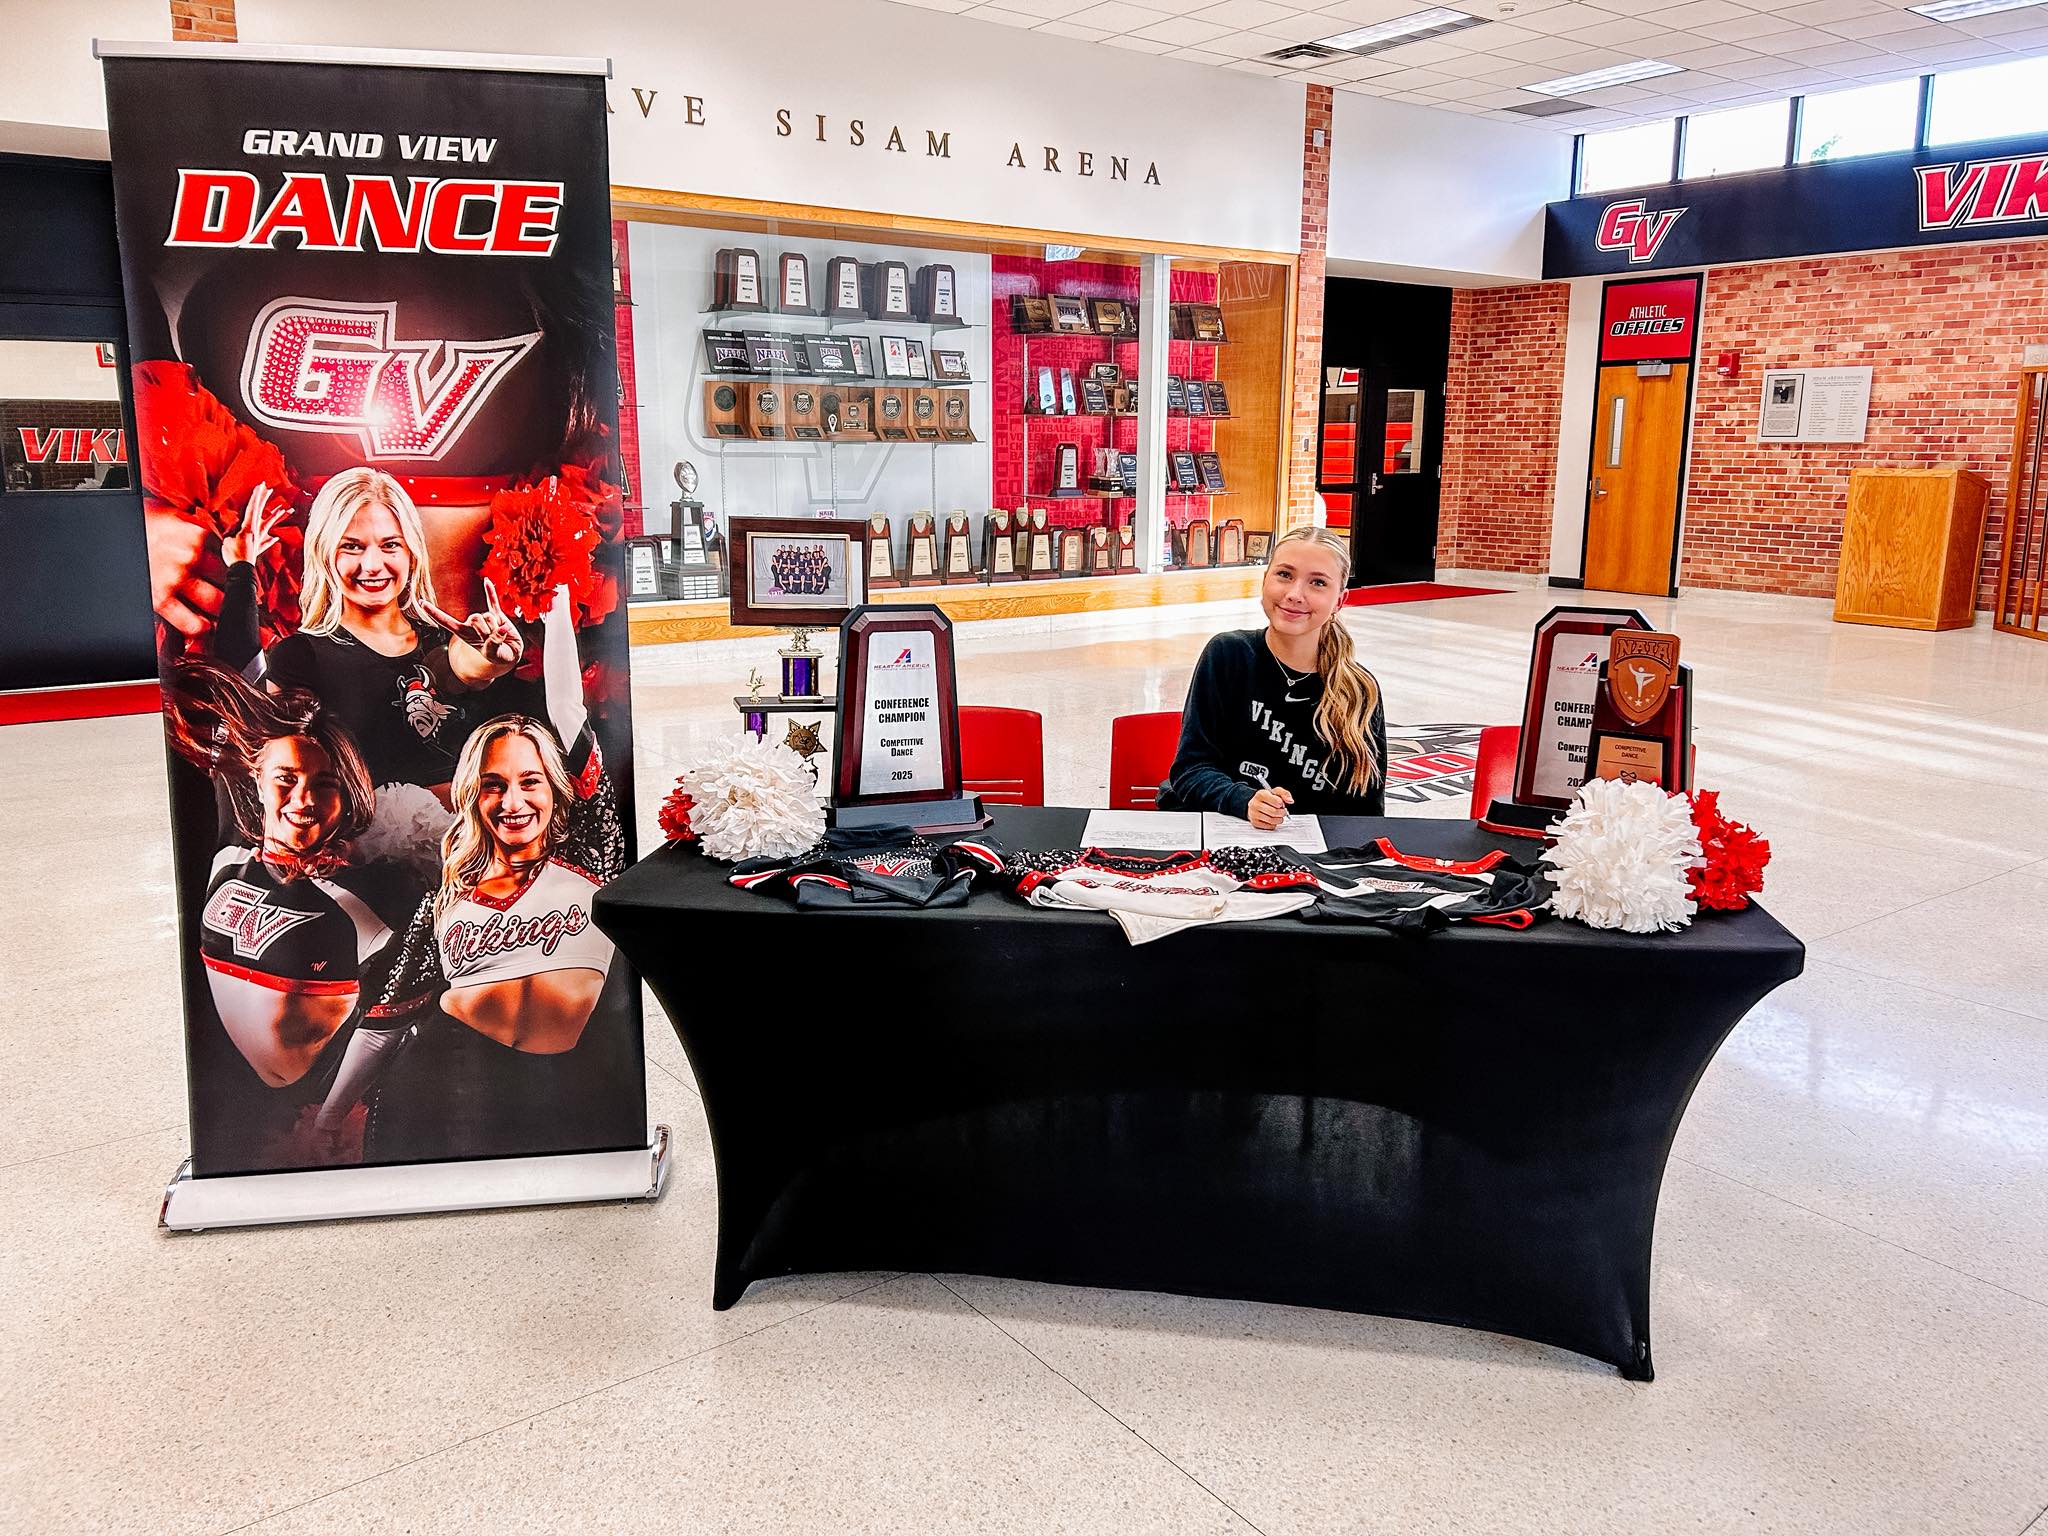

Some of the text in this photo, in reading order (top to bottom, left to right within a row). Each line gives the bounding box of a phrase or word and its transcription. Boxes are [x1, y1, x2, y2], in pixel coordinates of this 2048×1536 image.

[243, 129, 498, 163] GRAND VIEW
[606, 88, 1161, 186] VE SISAM ARENA
[164, 169, 564, 257] DANCE
[1594, 198, 1690, 264] GV
[1610, 317, 1685, 337] OFFICES
[1629, 305, 1668, 320] ATHLETIC
[755, 348, 789, 364] NAIA
[241, 296, 545, 461] GV
[1616, 637, 1673, 662] NAIA
[874, 698, 930, 710] CONFERENCE
[878, 712, 926, 723] CHAMPION
[1251, 699, 1329, 791] VIKINGS
[1615, 744, 1647, 753] COMPETITIVE
[891, 770, 913, 781] 2025
[203, 878, 325, 961] GV
[443, 904, 589, 966] Vikings
